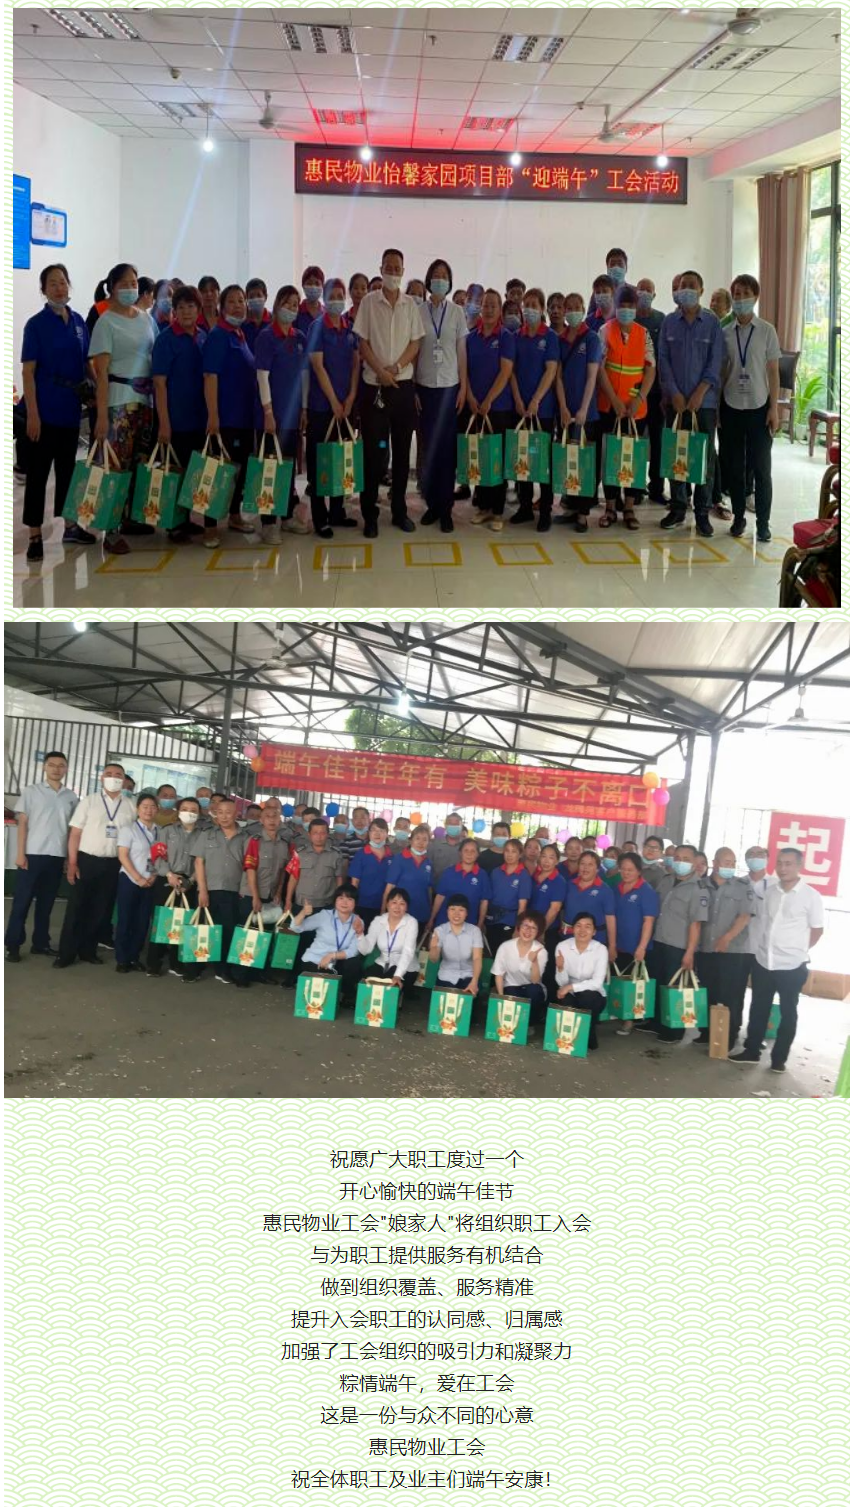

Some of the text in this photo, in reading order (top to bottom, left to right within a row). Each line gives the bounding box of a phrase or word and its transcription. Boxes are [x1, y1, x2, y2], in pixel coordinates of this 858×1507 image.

[273, 748, 653, 809] 端午佳节年年有 美味粽子不离口
[775, 821, 833, 885] 起
